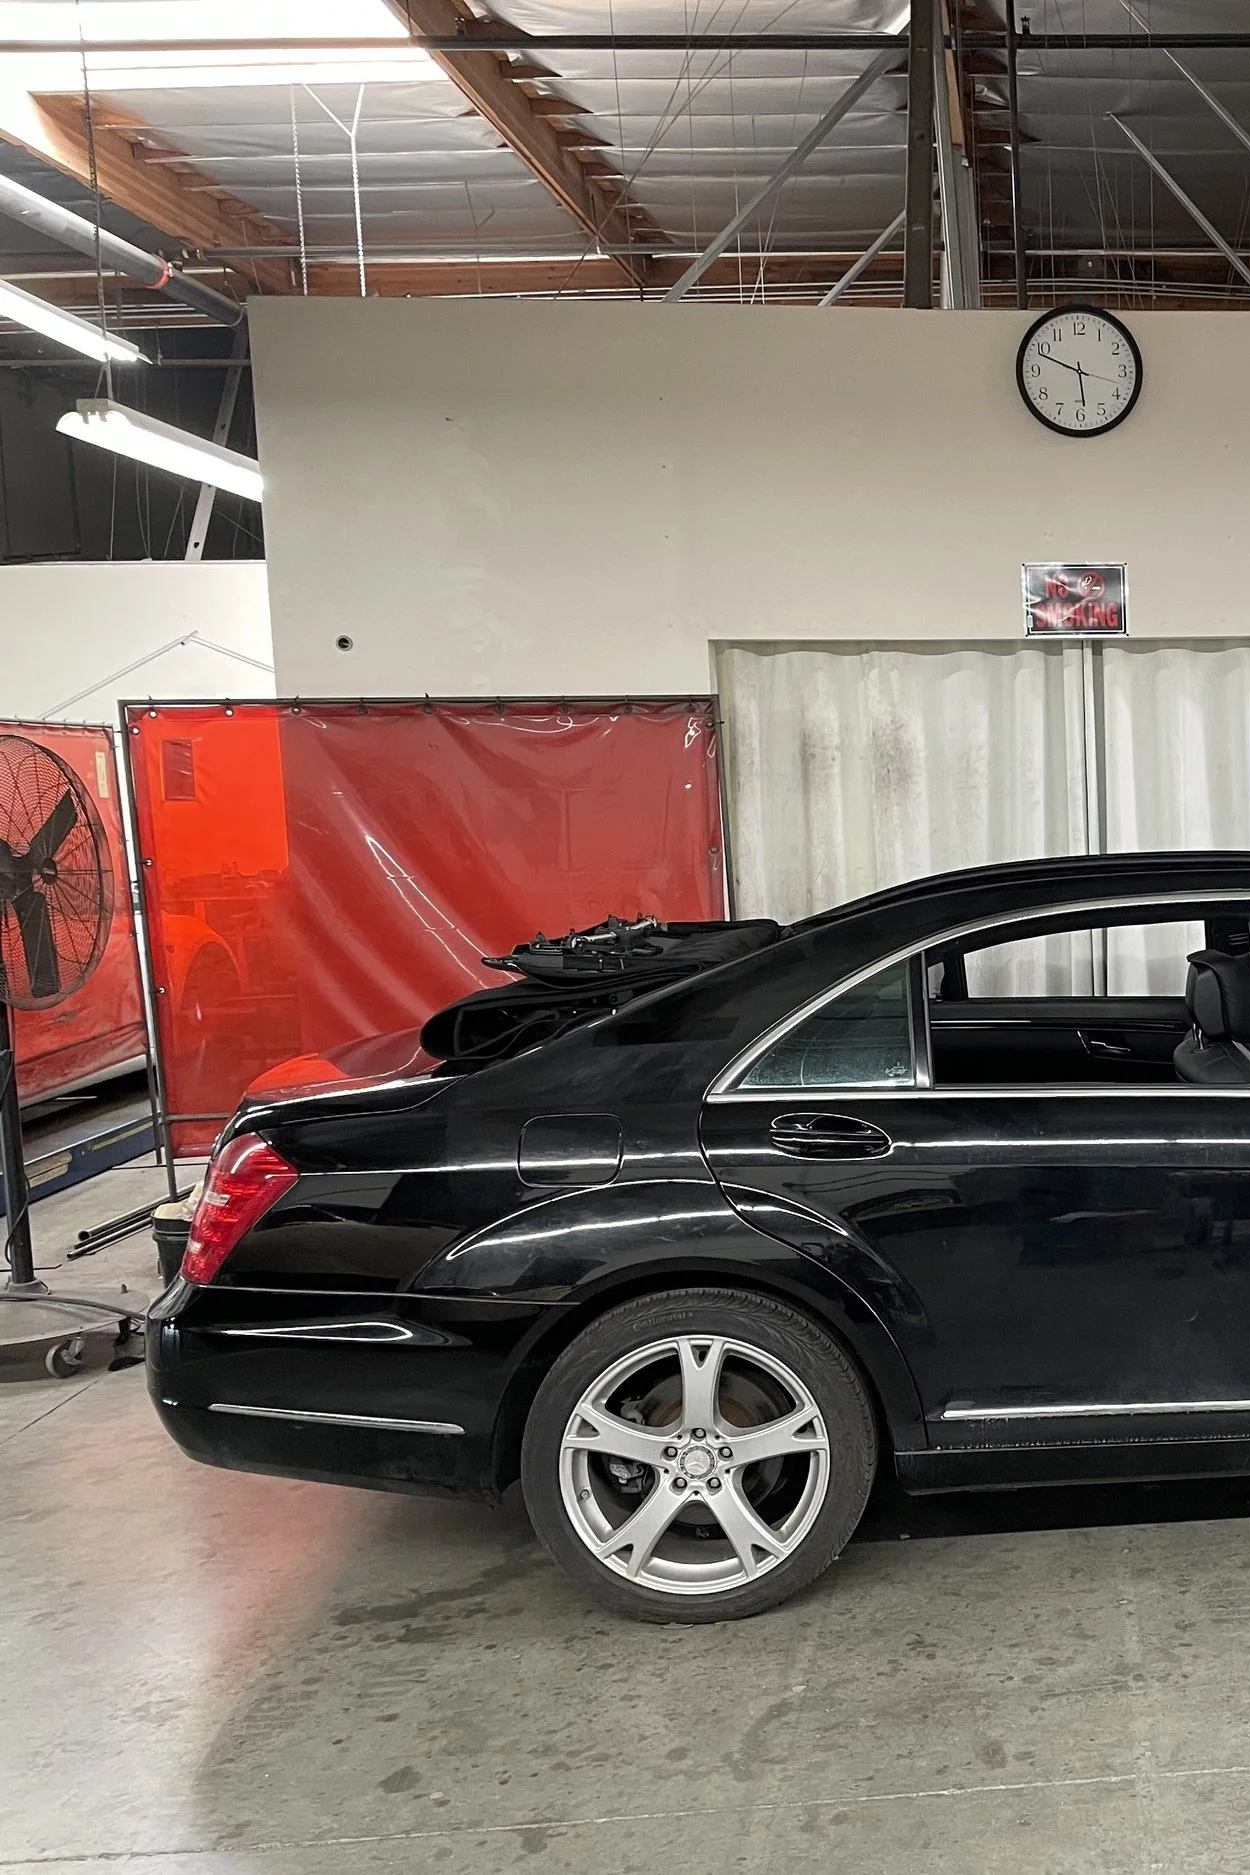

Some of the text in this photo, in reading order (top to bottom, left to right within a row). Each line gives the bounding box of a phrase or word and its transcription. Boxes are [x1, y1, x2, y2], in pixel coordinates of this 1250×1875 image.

[1053, 329, 1062, 342] 11
[1073, 322, 1086, 336] 12
[1097, 329, 1102, 342] 1
[1037, 342, 1051, 355] 10
[1111, 342, 1120, 355] 2
[1031, 364, 1041, 378] 9
[1118, 364, 1127, 378] 3
[1038, 387, 1048, 400] 8
[1111, 387, 1121, 400] 4
[1055, 402, 1064, 415] 7
[1075, 408, 1086, 422] 6
[1096, 402, 1106, 416] 5
[1044, 573, 1069, 598] NO
[1035, 602, 1119, 628] SMOKING
